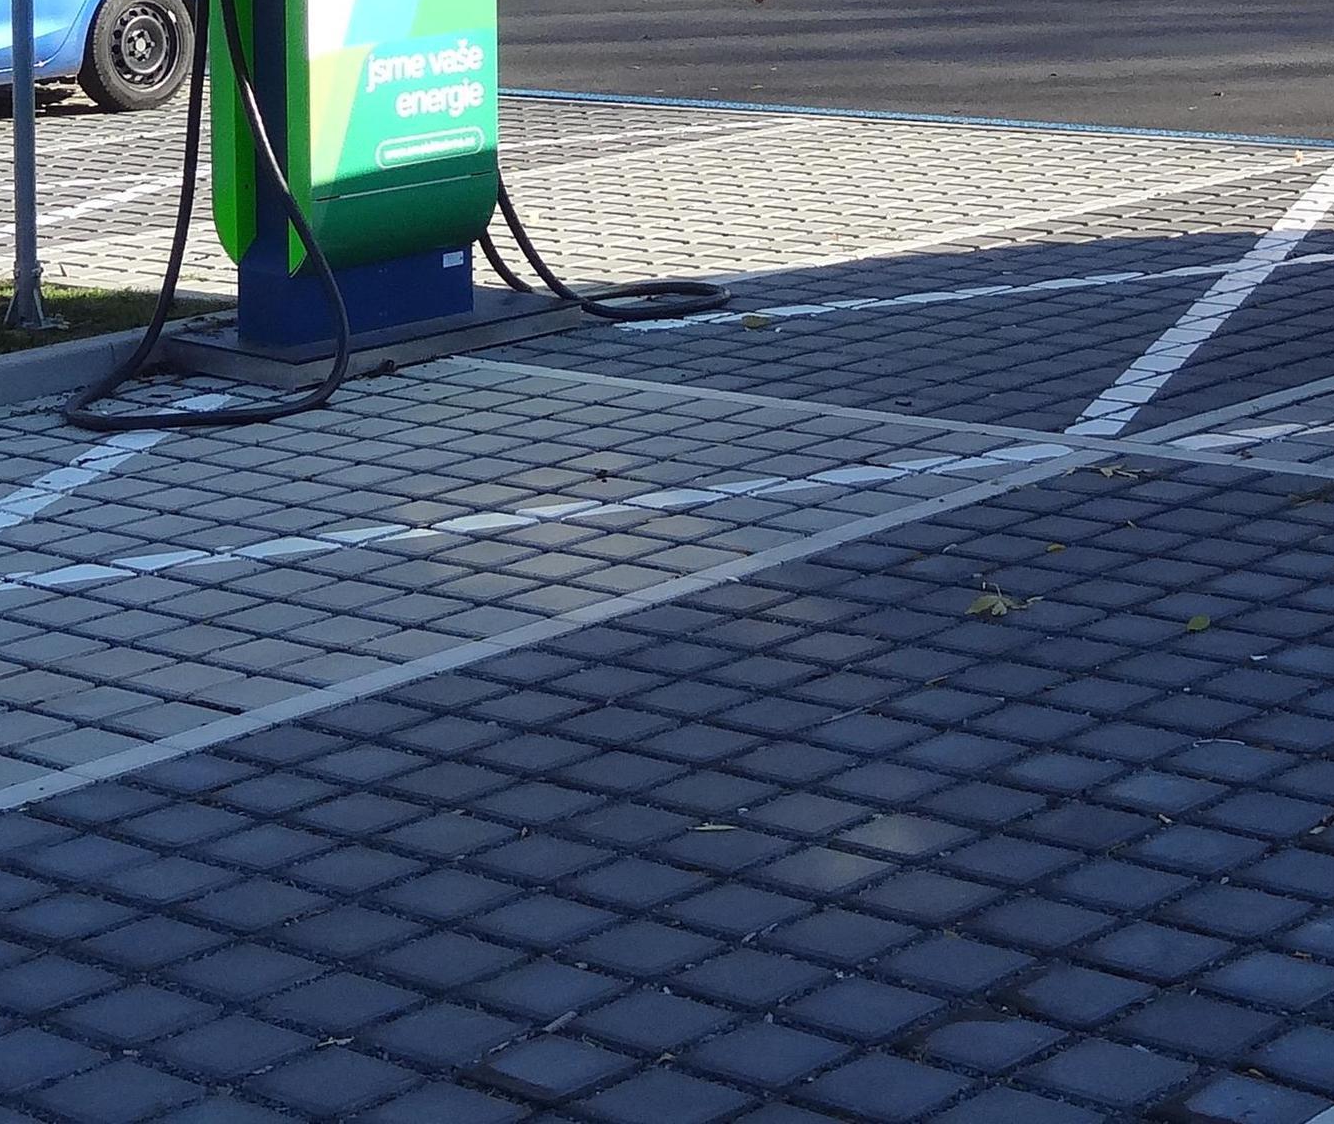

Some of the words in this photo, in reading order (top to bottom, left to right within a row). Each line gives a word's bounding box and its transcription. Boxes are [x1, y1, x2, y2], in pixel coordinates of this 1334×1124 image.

[366, 54, 426, 93] jsme
[429, 40, 484, 75] vaše
[395, 79, 484, 117] energie
